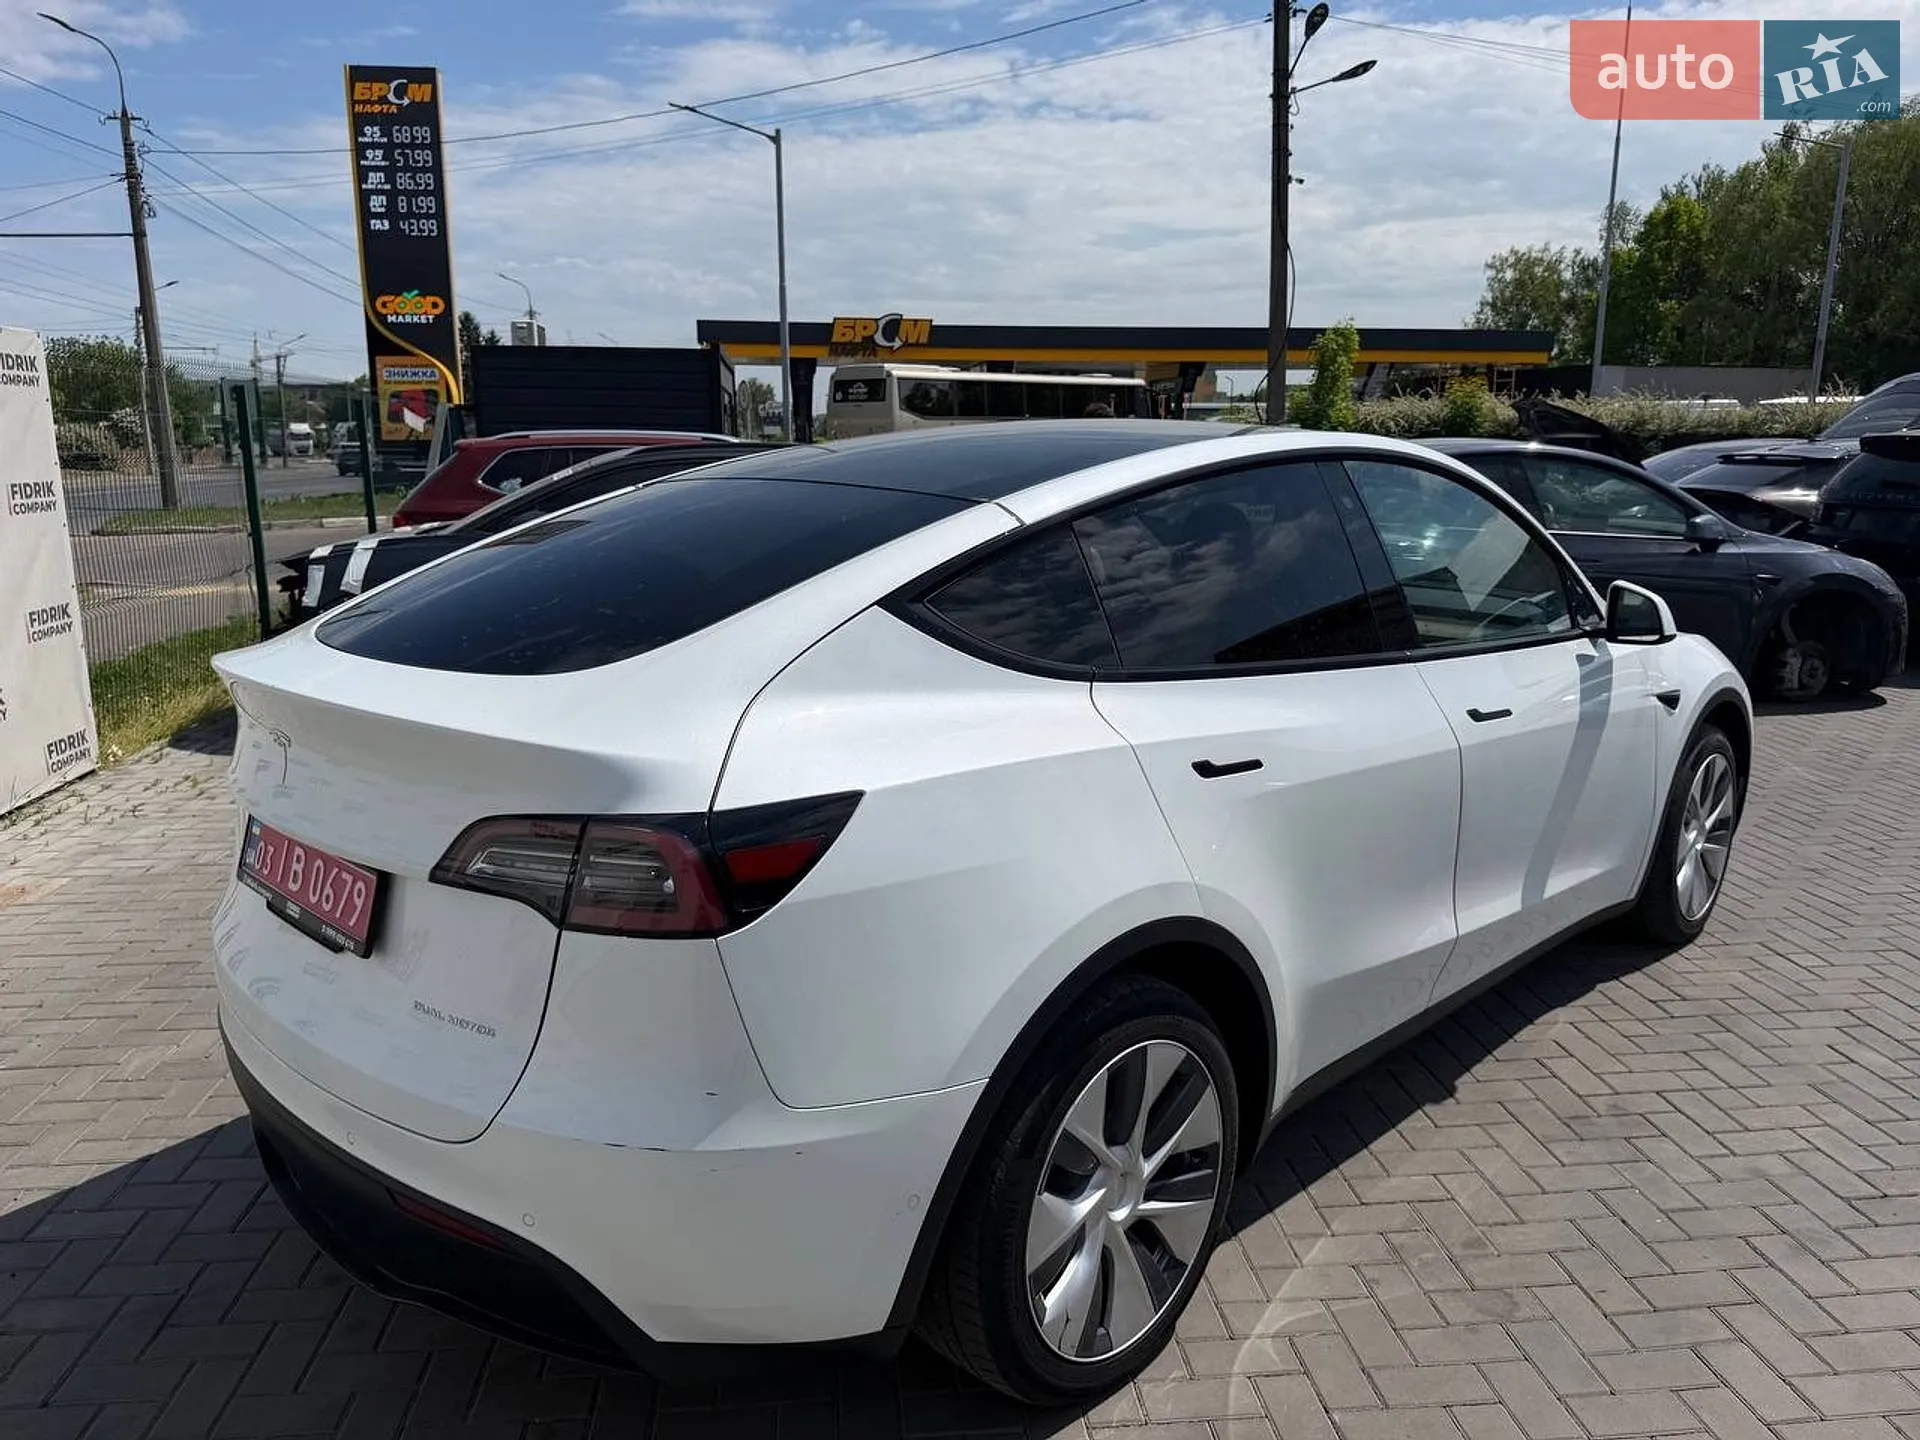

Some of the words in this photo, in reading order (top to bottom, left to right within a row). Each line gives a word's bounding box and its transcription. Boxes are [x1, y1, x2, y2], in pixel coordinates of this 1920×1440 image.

[353, 79, 432, 106] БРСМ
[354, 104, 397, 114] НАФТА
[364, 126, 381, 138] 95
[366, 149, 384, 161] 95
[394, 149, 433, 167] 57.99
[396, 172, 435, 190] 86.99
[397, 196, 436, 214] 81.99
[370, 219, 390, 230] ГАЗ
[399, 219, 438, 236] 43.99
[375, 294, 446, 315] GOOD
[386, 314, 436, 324] MARKET
[831, 313, 933, 350] БРСМ
[0, 352, 39, 373] IDRIK
[0, 373, 40, 388] OMPANY
[10, 481, 56, 500] FIDRIK
[13, 499, 57, 515] COMPANY
[28, 602, 71, 628] FIDRIK
[31, 621, 73, 642] COMPANY
[47, 728, 89, 760] FIDRIK
[50, 746, 91, 773] COMPANY
[254, 840, 274, 875] 03
[309, 858, 367, 928] 0679
